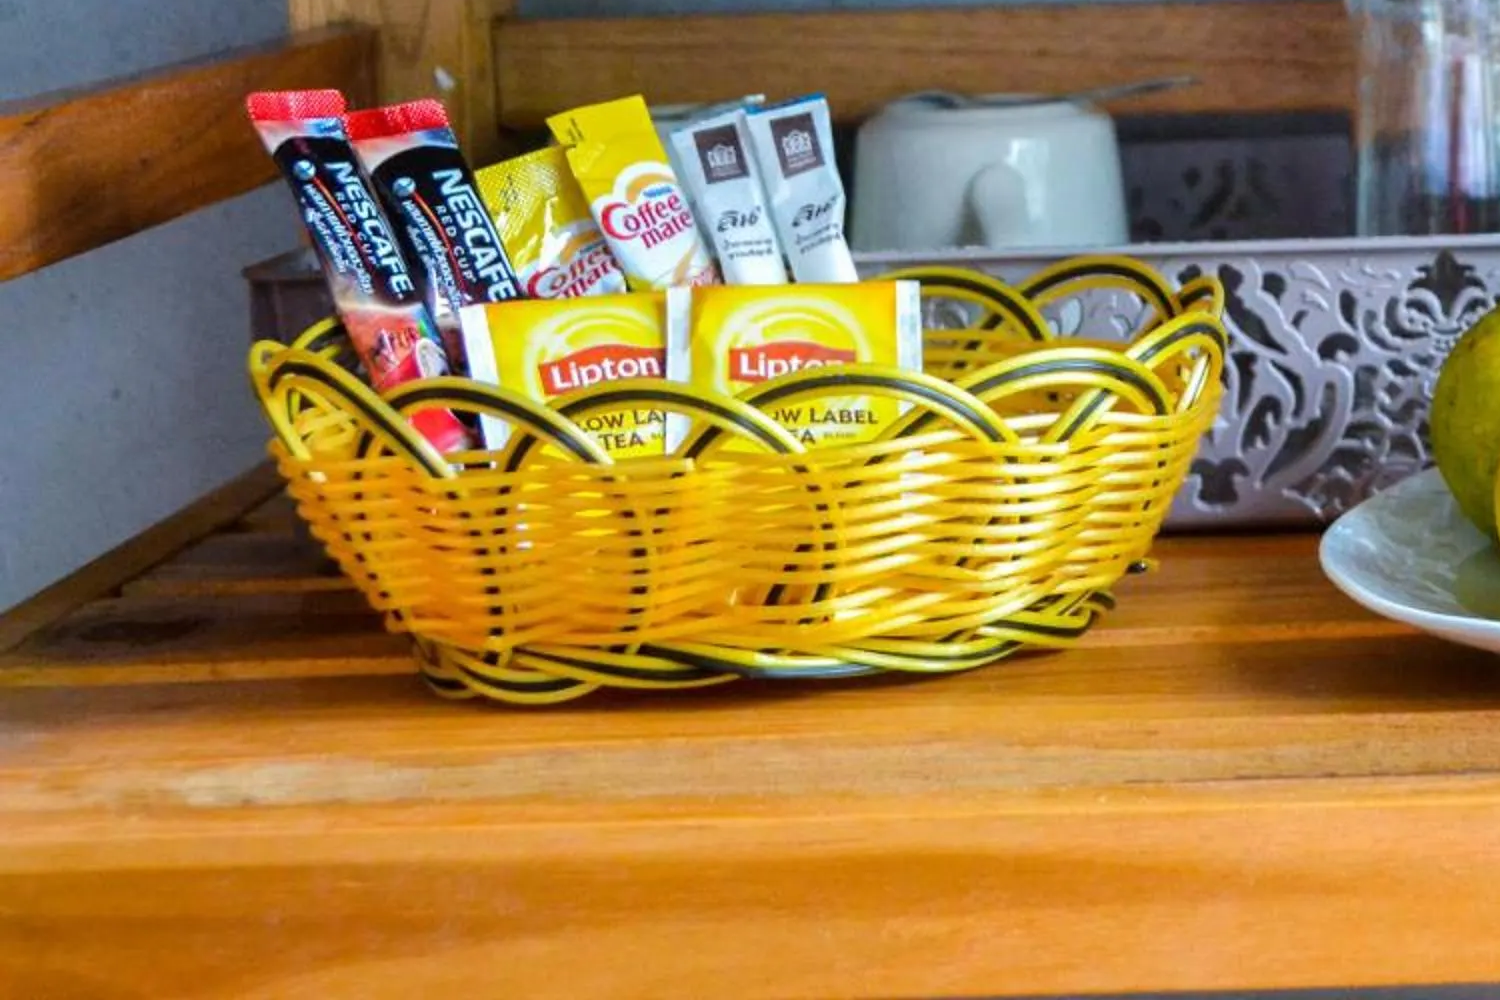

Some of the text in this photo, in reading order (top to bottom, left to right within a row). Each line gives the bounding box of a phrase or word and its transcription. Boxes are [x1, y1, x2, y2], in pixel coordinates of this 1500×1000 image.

[601, 193, 684, 241] Coffee
[640, 209, 694, 249] mate
[435, 204, 474, 281] RED CUP
[550, 355, 660, 389] Lipton
[740, 352, 844, 379] Lipt
[809, 407, 879, 425] LABEL
[598, 431, 645, 452] TEA
